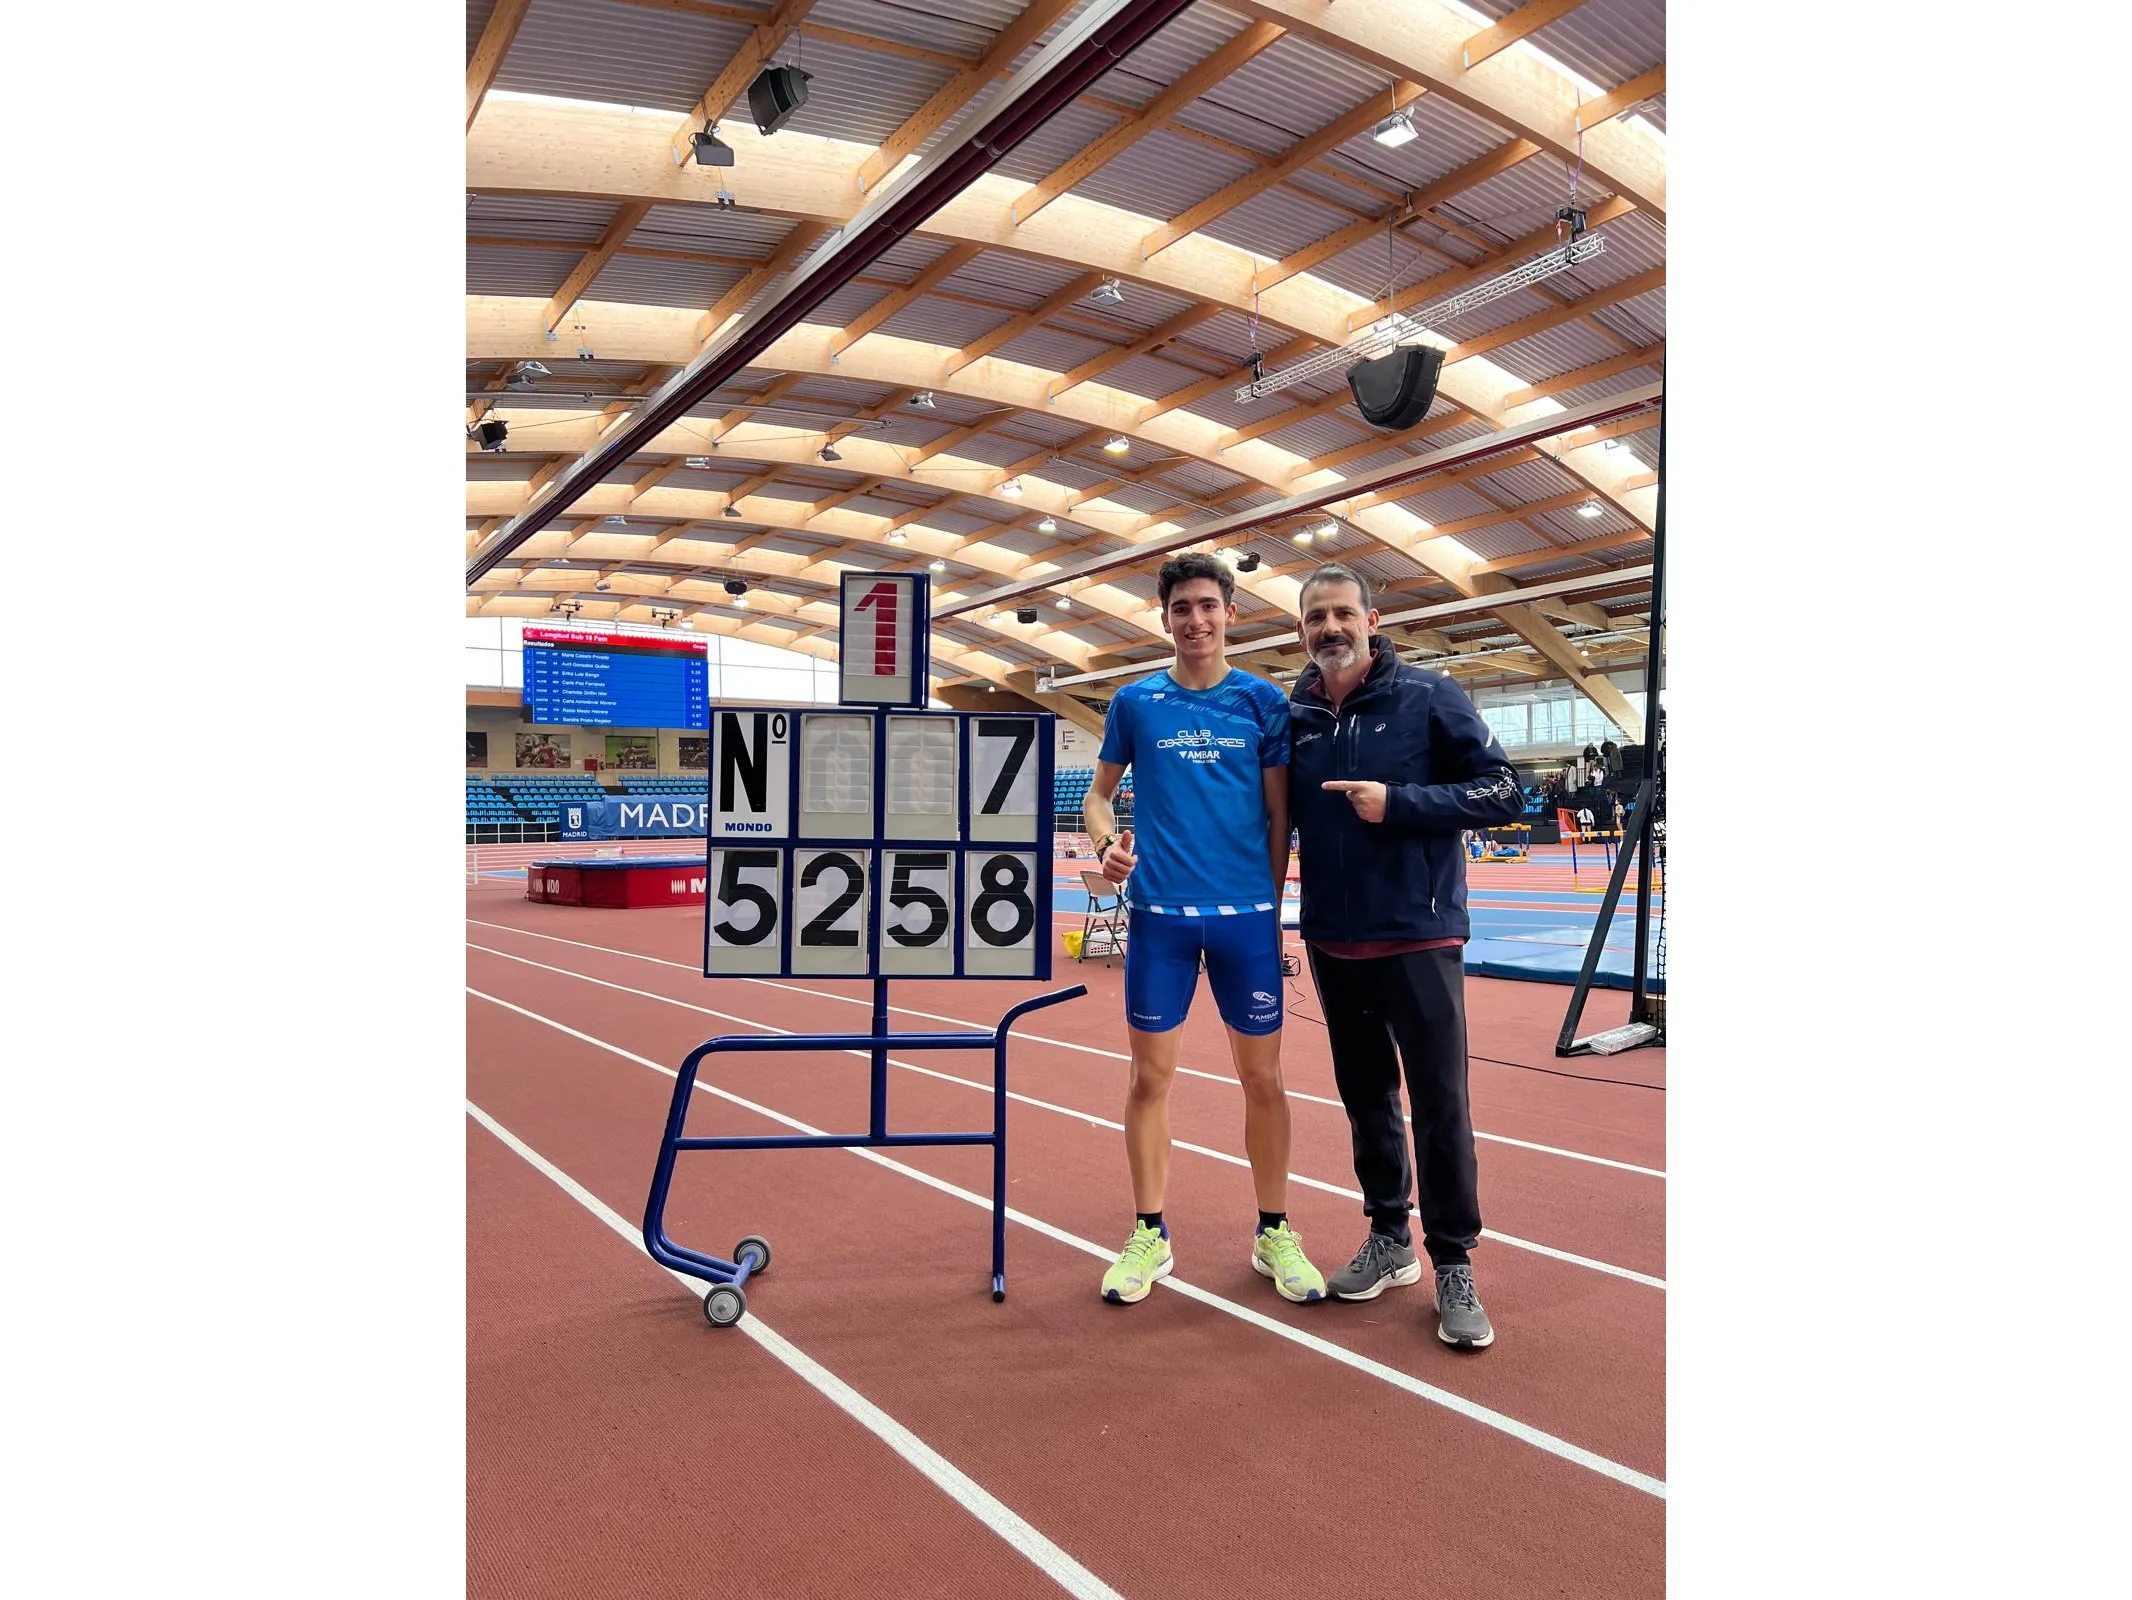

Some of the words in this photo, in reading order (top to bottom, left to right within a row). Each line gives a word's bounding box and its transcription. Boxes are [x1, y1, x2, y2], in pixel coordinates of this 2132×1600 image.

[854, 583, 898, 676] 1
[1177, 729, 1211, 738] CLUB
[1187, 750, 1221, 760] AMBAR
[978, 719, 1036, 815] 7
[725, 822, 772, 832] MONDO
